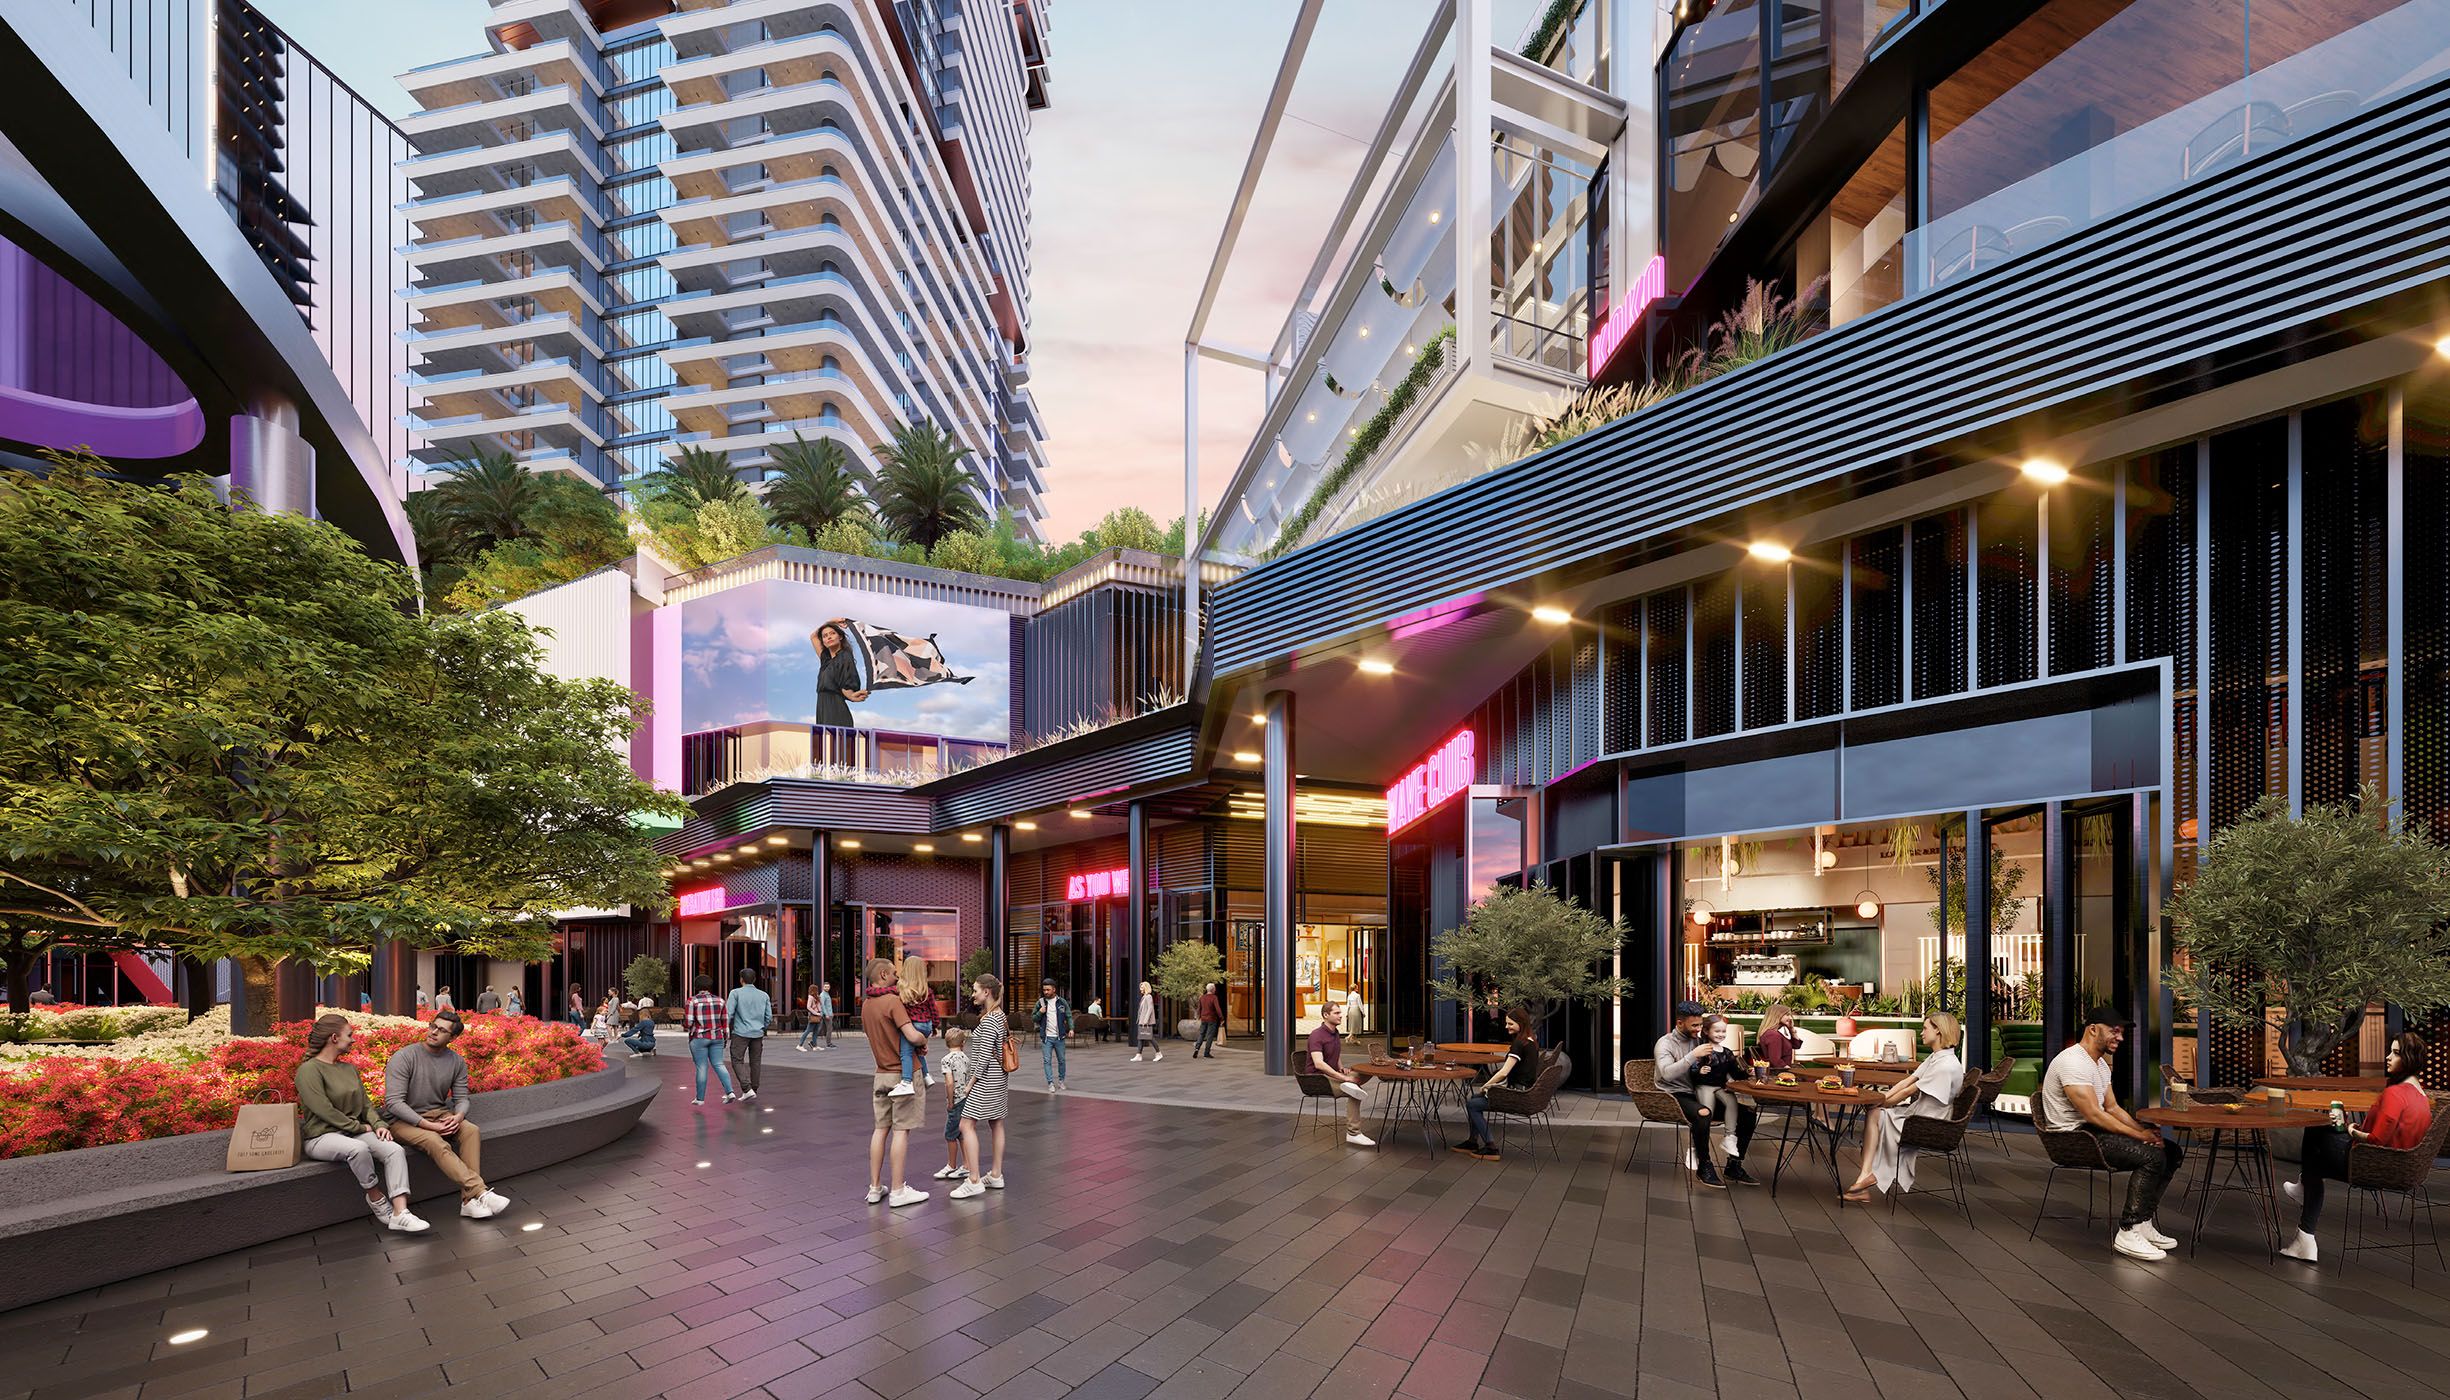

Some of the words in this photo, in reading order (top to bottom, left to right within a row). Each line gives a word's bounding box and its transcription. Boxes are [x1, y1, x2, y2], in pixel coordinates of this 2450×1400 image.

[1591, 255, 1665, 379] KOKO
[1386, 763, 1427, 836] WAVE
[1427, 730, 1475, 809] CLUB
[1068, 875, 1085, 900] AS
[1085, 871, 1111, 898] YOU
